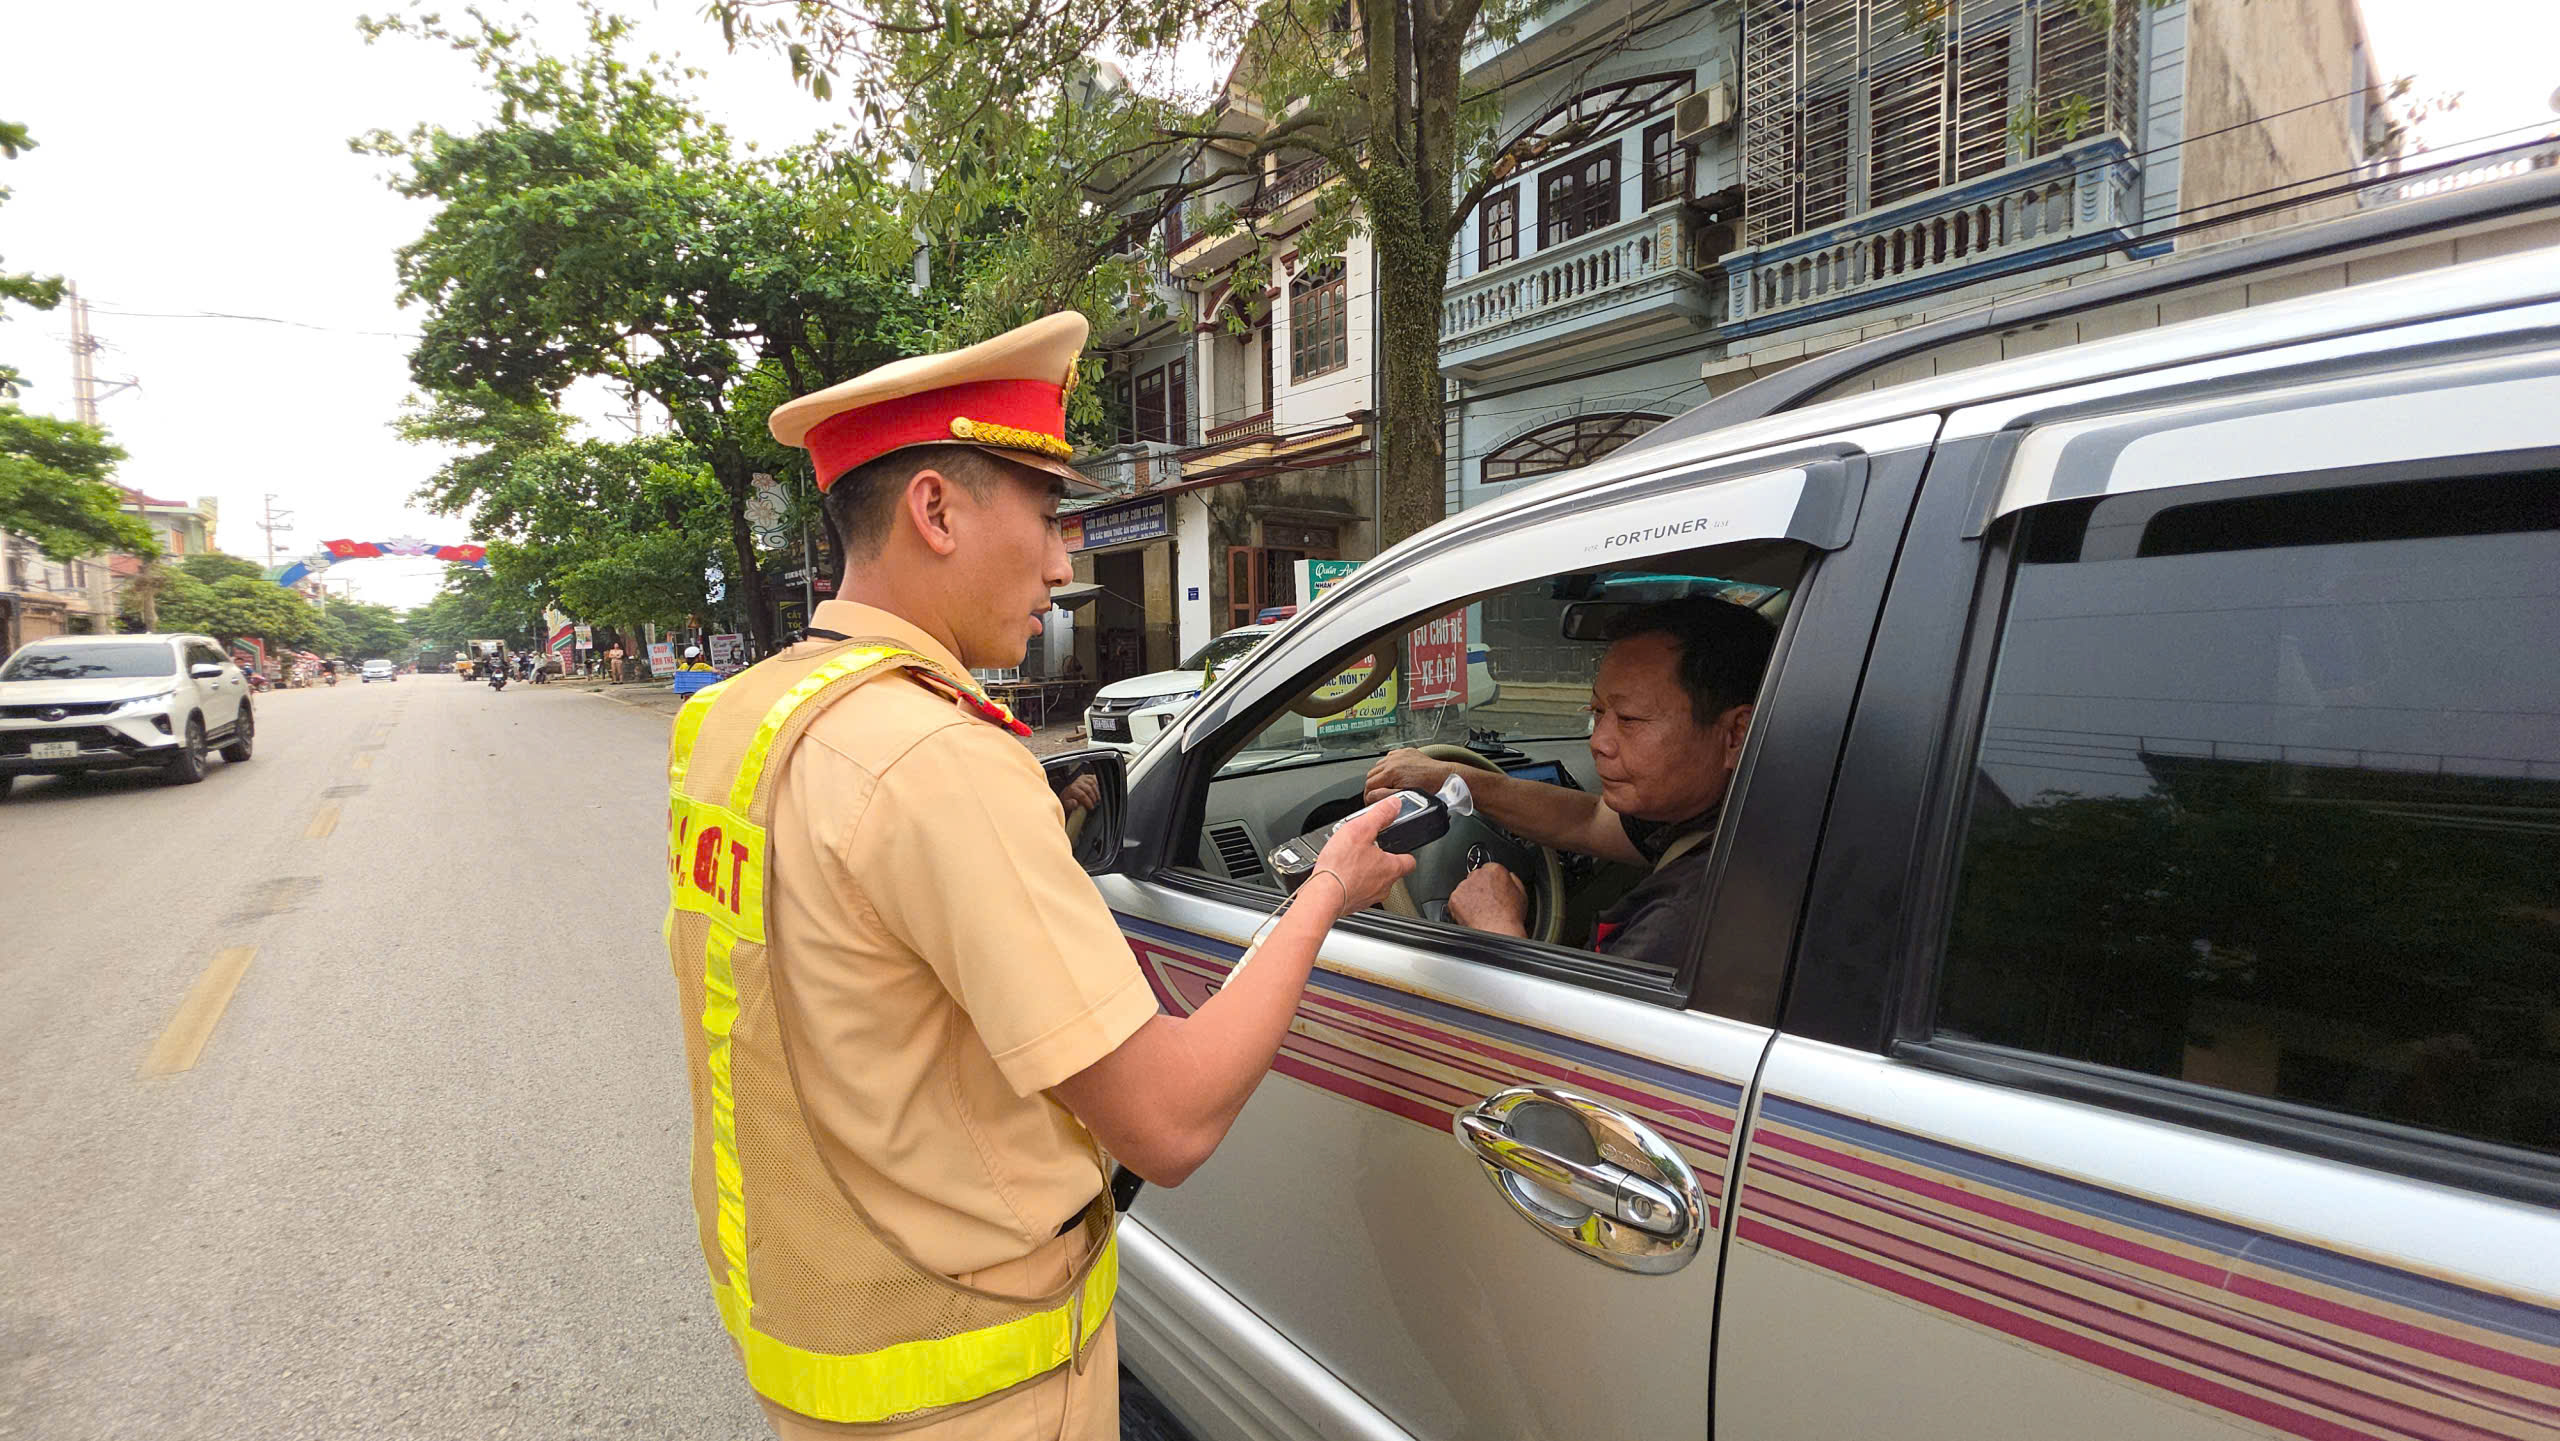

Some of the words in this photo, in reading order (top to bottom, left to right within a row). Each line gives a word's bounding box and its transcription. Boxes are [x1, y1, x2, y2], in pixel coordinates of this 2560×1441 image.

[1604, 518, 1709, 549] FORTUNER
[1315, 563, 1337, 579] Quán
[1422, 660, 1433, 686] XE
[1436, 653, 1443, 684] Ô
[1444, 651, 1456, 683] TÔ
